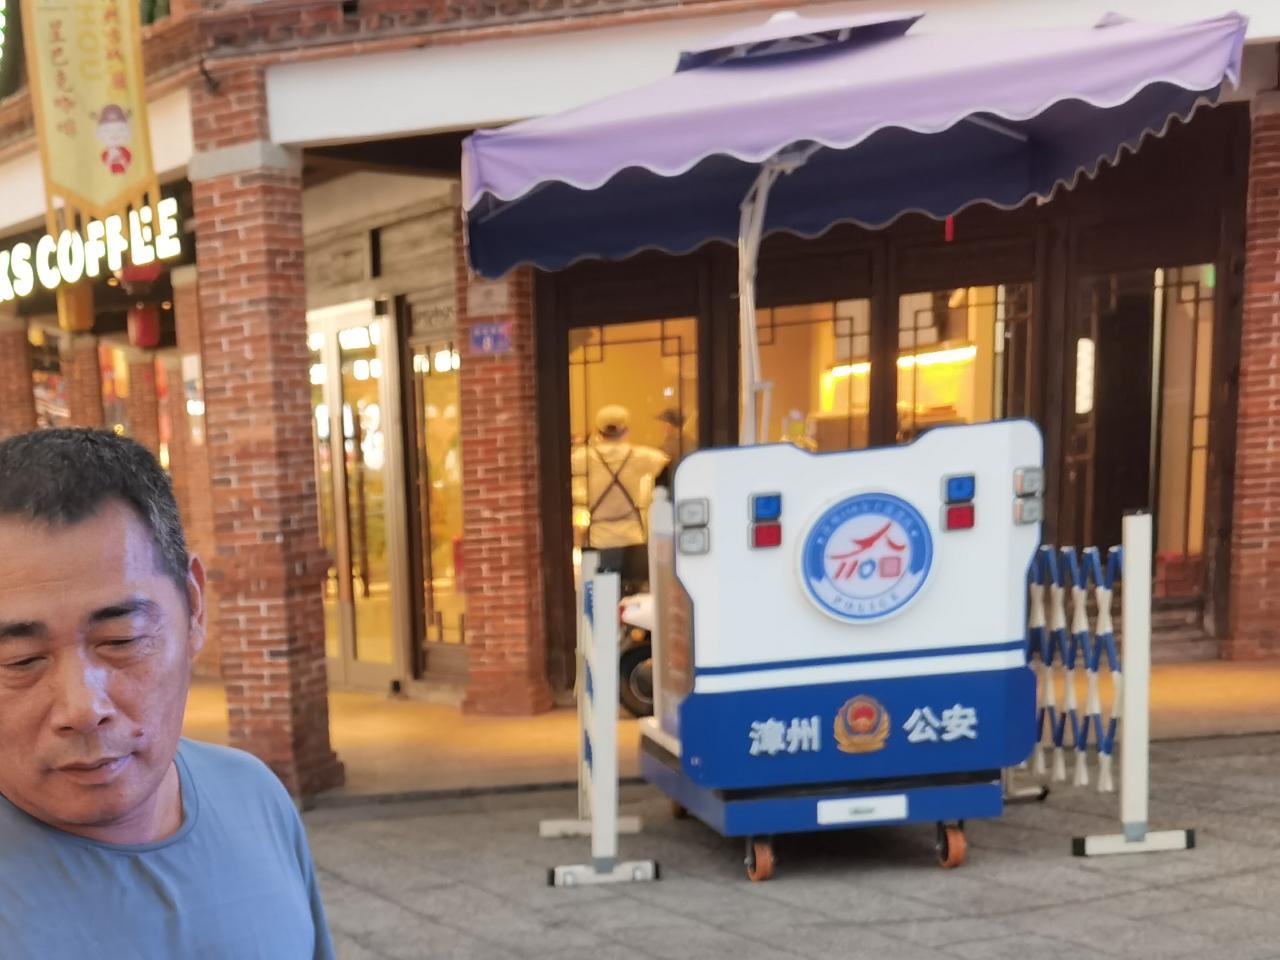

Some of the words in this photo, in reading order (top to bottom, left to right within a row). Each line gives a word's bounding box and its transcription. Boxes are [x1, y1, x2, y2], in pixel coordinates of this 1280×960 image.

[35, 197, 182, 289] COFFEE
[749, 716, 821, 756] 漳州
[903, 704, 978, 743] 公安
